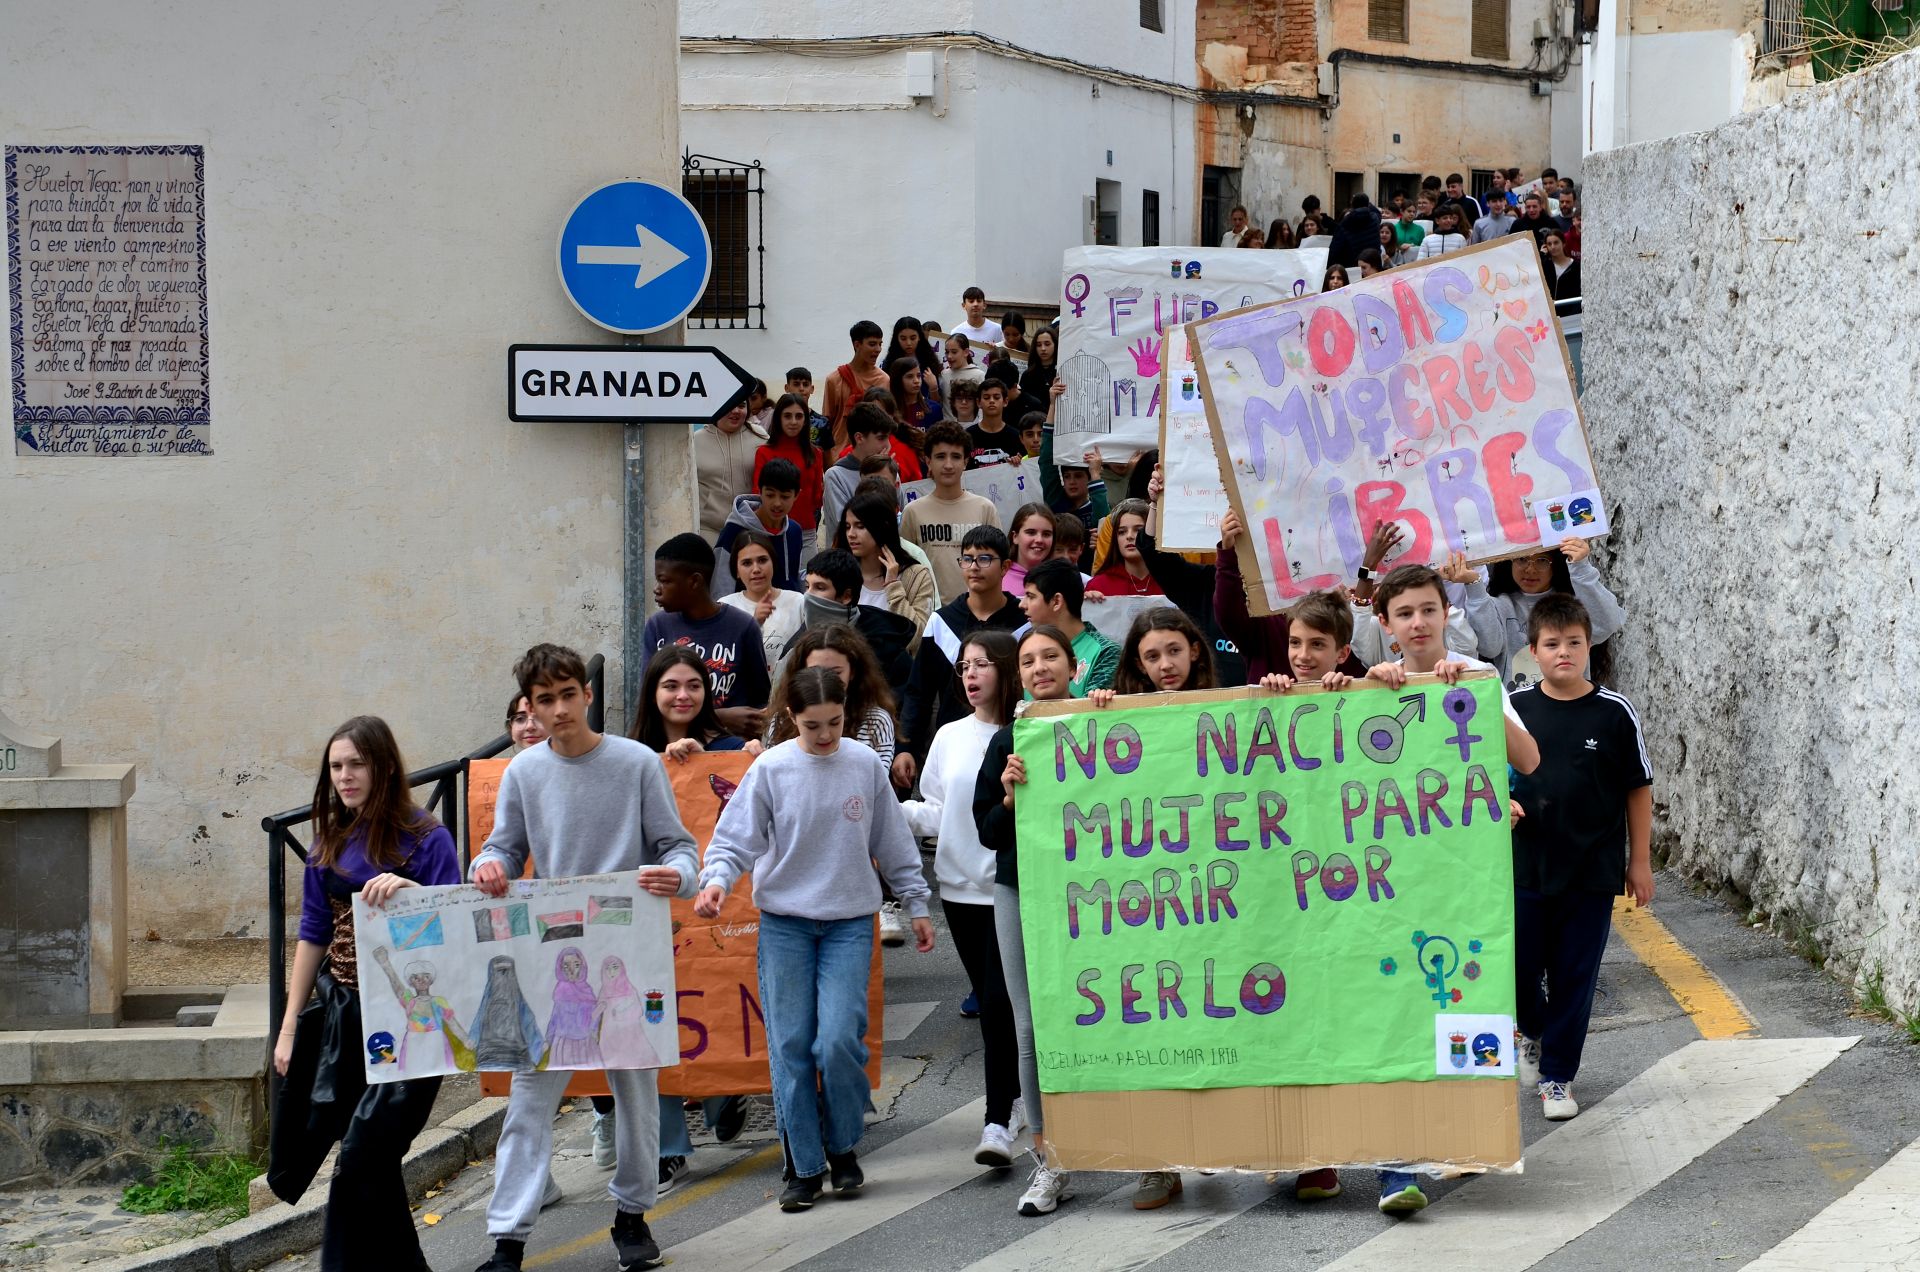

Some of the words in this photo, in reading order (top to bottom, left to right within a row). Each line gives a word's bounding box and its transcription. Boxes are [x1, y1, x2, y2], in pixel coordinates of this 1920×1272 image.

[23, 163, 84, 193] Huetor
[87, 168, 122, 201] Vega:
[127, 180, 151, 198] pan
[155, 180, 164, 202] y
[166, 180, 195, 194] vino
[28, 198, 64, 221] para
[68, 192, 115, 213] brindar
[121, 200, 142, 221] por
[147, 194, 159, 213] la
[164, 195, 193, 213] vida
[29, 220, 63, 241] para
[67, 214, 88, 233] dar
[92, 213, 105, 233] la
[113, 213, 185, 234] bienvenida
[30, 239, 41, 252] a
[47, 239, 67, 252] ese
[74, 236, 116, 253] viento
[123, 239, 195, 259] campesino
[30, 259, 52, 279] que
[58, 257, 90, 273] viene
[97, 258, 117, 277] por
[122, 254, 134, 273] el
[140, 257, 189, 273] camino
[98, 274, 114, 293] de
[117, 273, 141, 293] olor
[32, 312, 81, 333] Huetor
[84, 314, 115, 341] Vega
[120, 314, 136, 333] de
[138, 313, 197, 333] Granada
[1208, 266, 1474, 388] TODAS
[35, 352, 70, 372] sobre
[74, 351, 86, 372] el
[89, 351, 129, 372] hombro
[135, 352, 153, 372] del
[110, 340, 131, 359] paz
[64, 381, 91, 399] José
[105, 382, 143, 399] Ladrón
[145, 382, 157, 399] de
[160, 382, 200, 399] Guevara
[521, 368, 708, 398] GRANADA
[55, 423, 168, 443] Ayuntamiento
[176, 424, 196, 440] de
[37, 438, 88, 453] Huetor
[93, 438, 129, 456] Vega
[132, 441, 145, 453] a
[146, 440, 162, 453] su
[163, 439, 207, 456] pueblo
[712, 643, 736, 665] ON
[1054, 718, 1143, 783] NO
[1063, 790, 1292, 861] MUJER
[1340, 764, 1503, 844] PARA
[1291, 845, 1396, 911] POR
